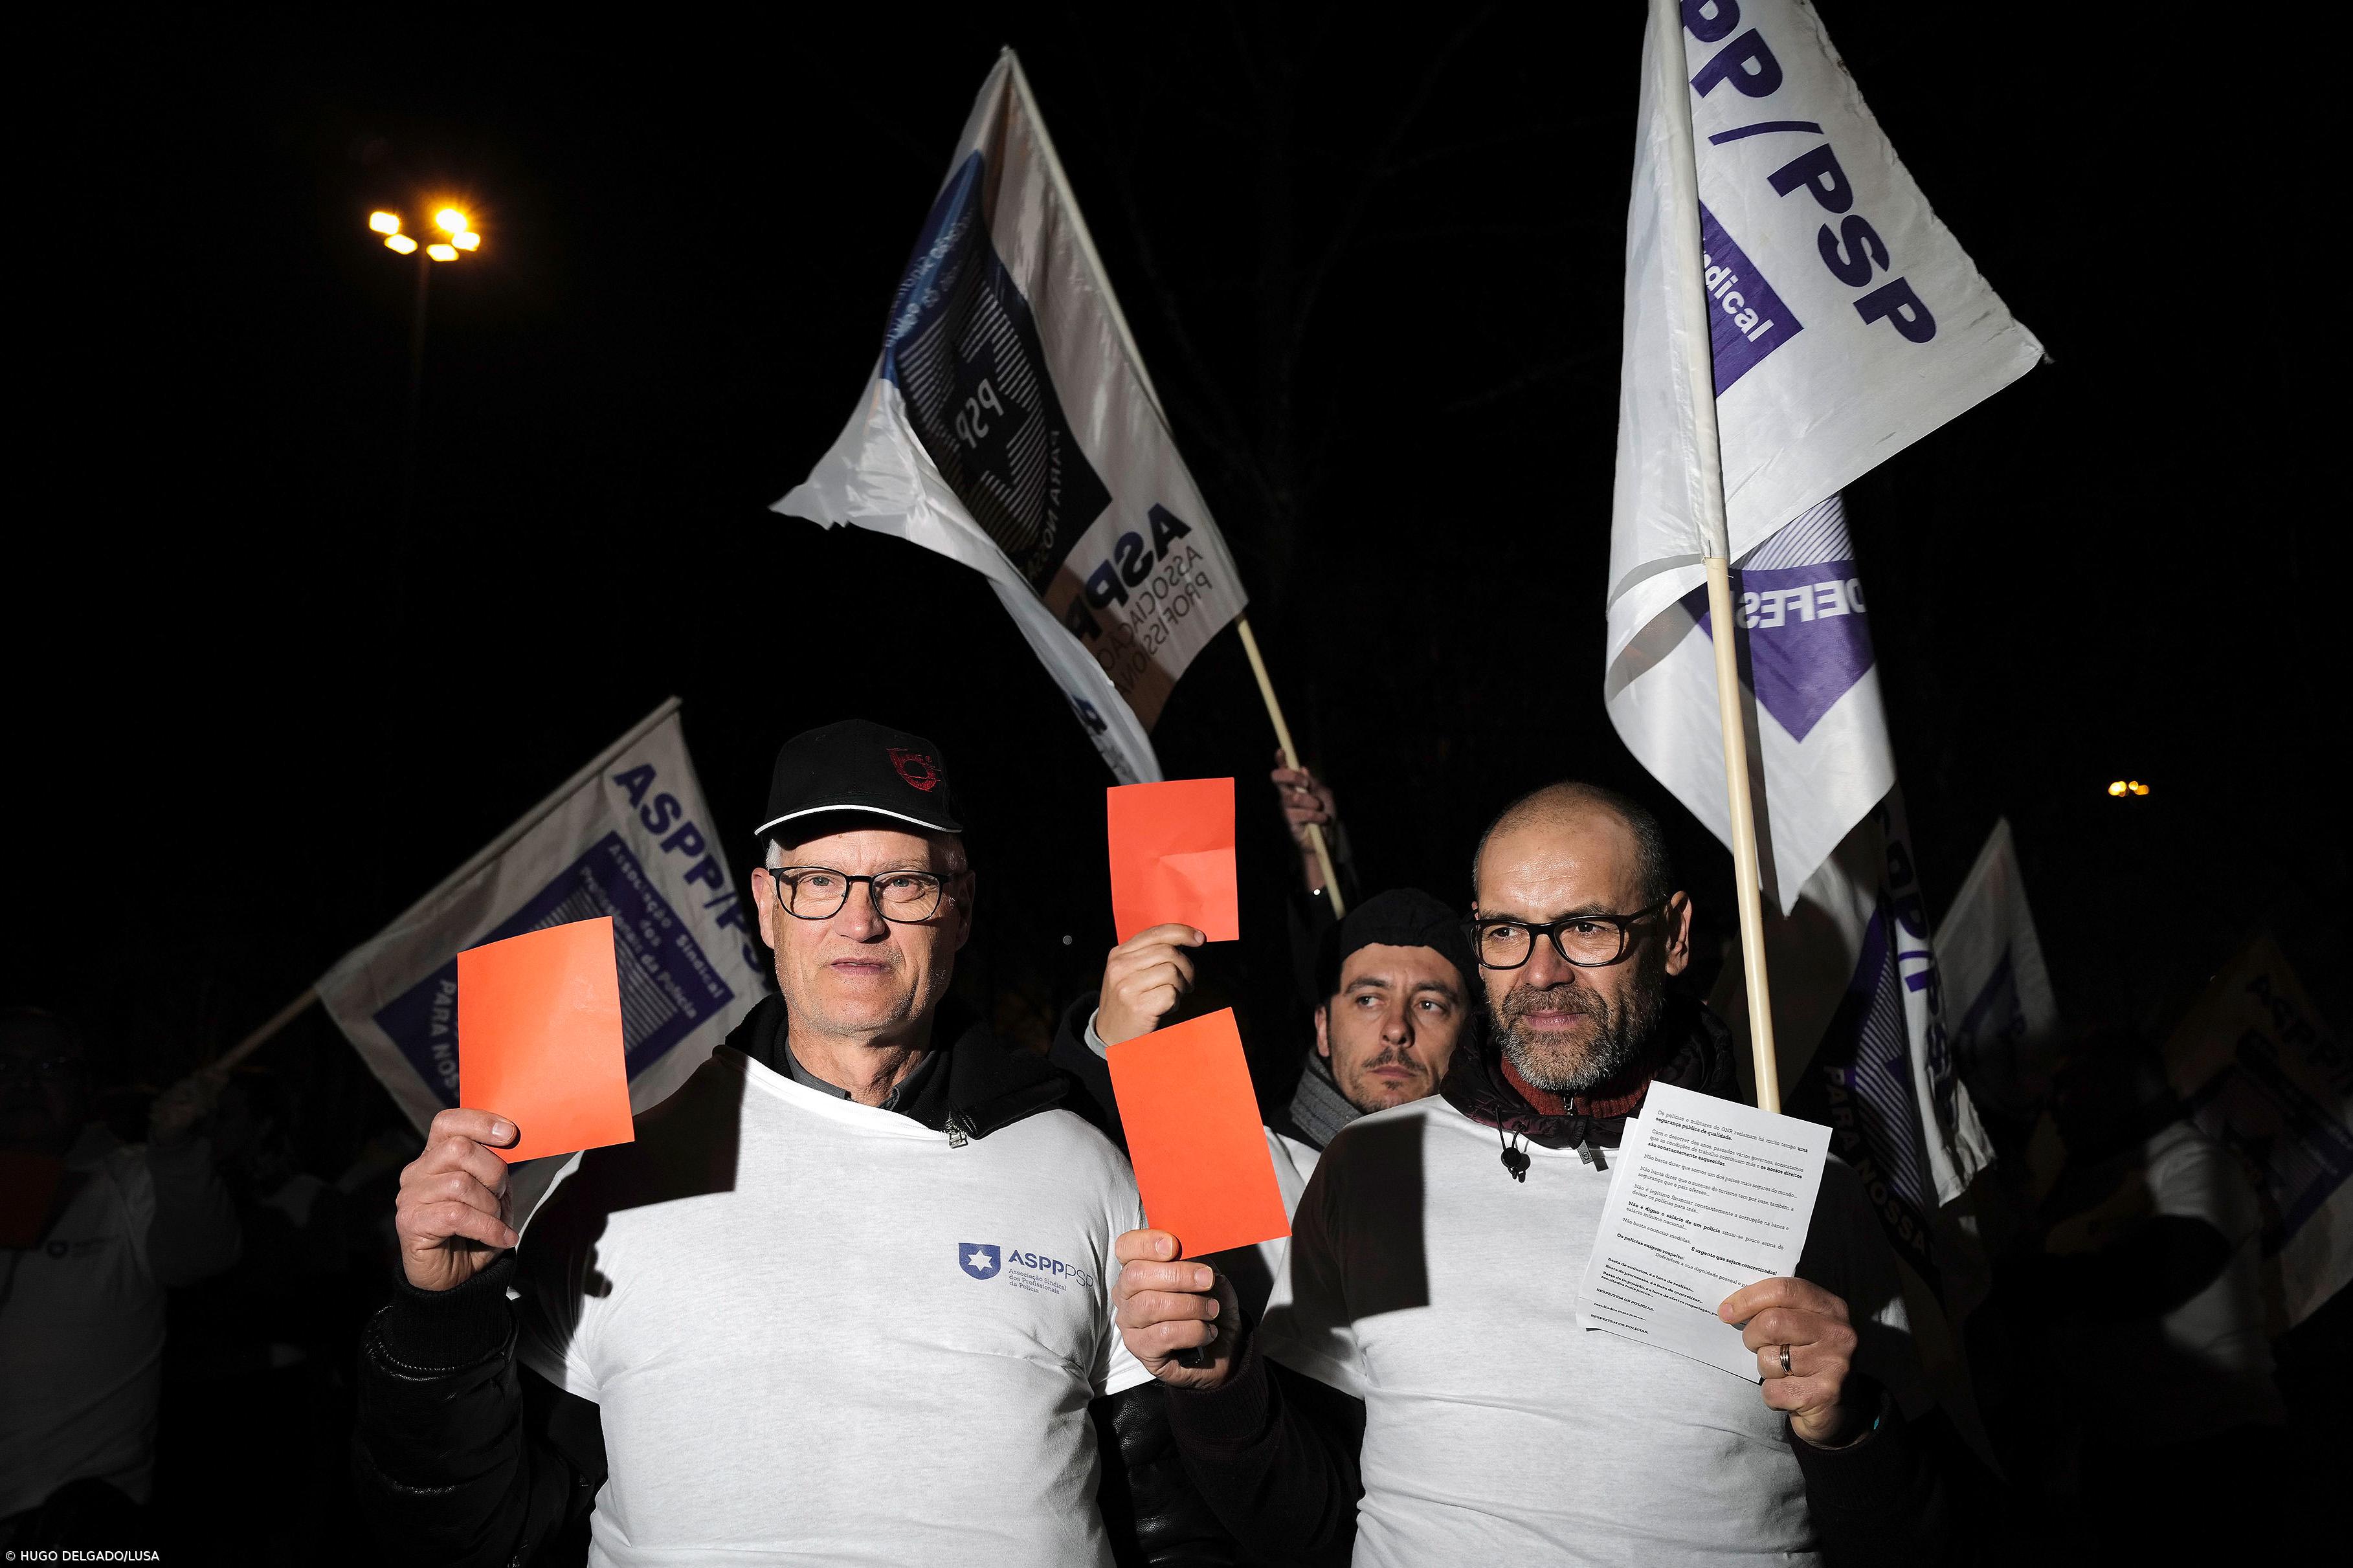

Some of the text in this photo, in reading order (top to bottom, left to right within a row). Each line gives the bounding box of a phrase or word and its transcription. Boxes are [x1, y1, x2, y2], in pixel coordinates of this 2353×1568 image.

[430, 978, 457, 1037] PARA
[1655, 1117, 1681, 1127] segurança
[1690, 1120, 1712, 1128] militares
[1734, 1131, 1758, 1140] reclamam
[1656, 1145, 1697, 1158] constantemente
[1666, 1141, 1690, 1150] condições
[1699, 1149, 1719, 1157] trabalho
[1719, 1155, 1745, 1164] continuam
[1783, 1170, 1802, 1178] direitos
[1668, 1134, 1689, 1143] decorrer
[1774, 1162, 1803, 1172] constatamos
[1638, 1173, 1663, 1183] segurança
[1632, 1189, 1648, 1198] deixar
[1649, 1188, 1670, 1198] legítimo
[1671, 1195, 1693, 1205] financiar
[1694, 1202, 1734, 1216] constantemente
[1738, 1213, 1764, 1224] corrupção
[1643, 1213, 1662, 1222] mínimo
[1633, 1220, 1646, 1229] basta
[1647, 1226, 1669, 1236] anunciar
[1722, 1231, 1743, 1239] situar-se
[1623, 1236, 1643, 1245] polícias
[1644, 1243, 1662, 1252] exigem
[1695, 1249, 1715, 1258] urgente
[1655, 1252, 1680, 1264] Defendem
[1693, 1266, 1718, 1278] dignidade
[1718, 1275, 1737, 1284] pessoal
[1009, 1268, 1067, 1292] Associação Sindical
[1009, 1274, 1060, 1295] dos Profissionais
[1019, 1283, 1040, 1294] Polícia
[1594, 1303, 1617, 1312] resultados
